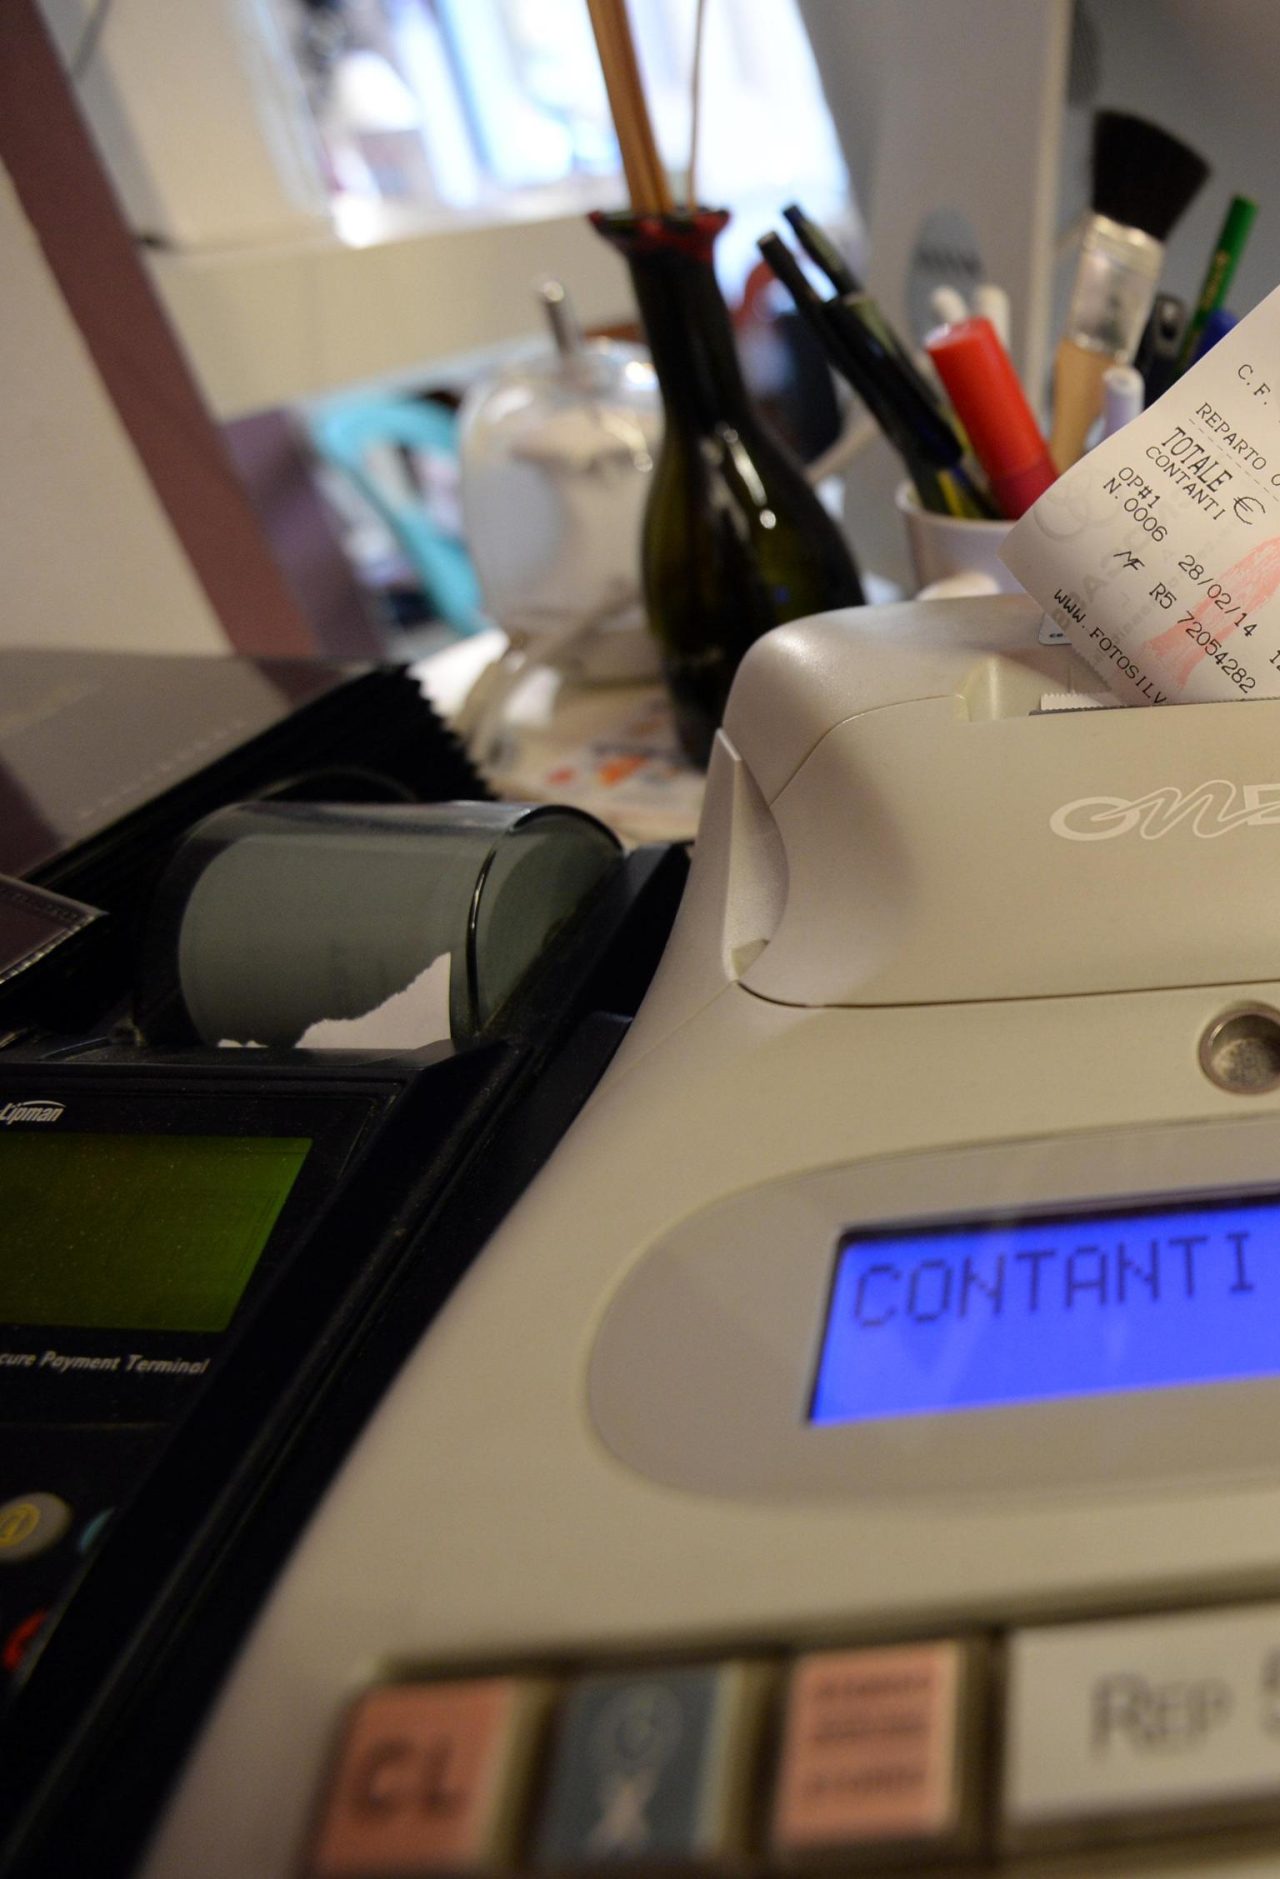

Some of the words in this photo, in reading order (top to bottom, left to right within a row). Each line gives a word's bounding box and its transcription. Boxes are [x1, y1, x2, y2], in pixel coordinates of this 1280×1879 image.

[1195, 402, 1267, 471] REPARTO
[1118, 466, 1161, 509] OP#1
[1145, 445, 1226, 521] CONTANTI
[1161, 426, 1234, 493] TOTALE
[1233, 495, 1268, 526] €
[1178, 554, 1259, 638] 28/02/14
[1149, 582, 1177, 610] R5
[1176, 610, 1257, 695] 72054282
[0, 1101, 66, 1125] Lipman
[853, 1231, 1256, 1328] CONTANTI
[40, 1350, 120, 1372] Payment
[126, 1354, 210, 1375] Terminal
